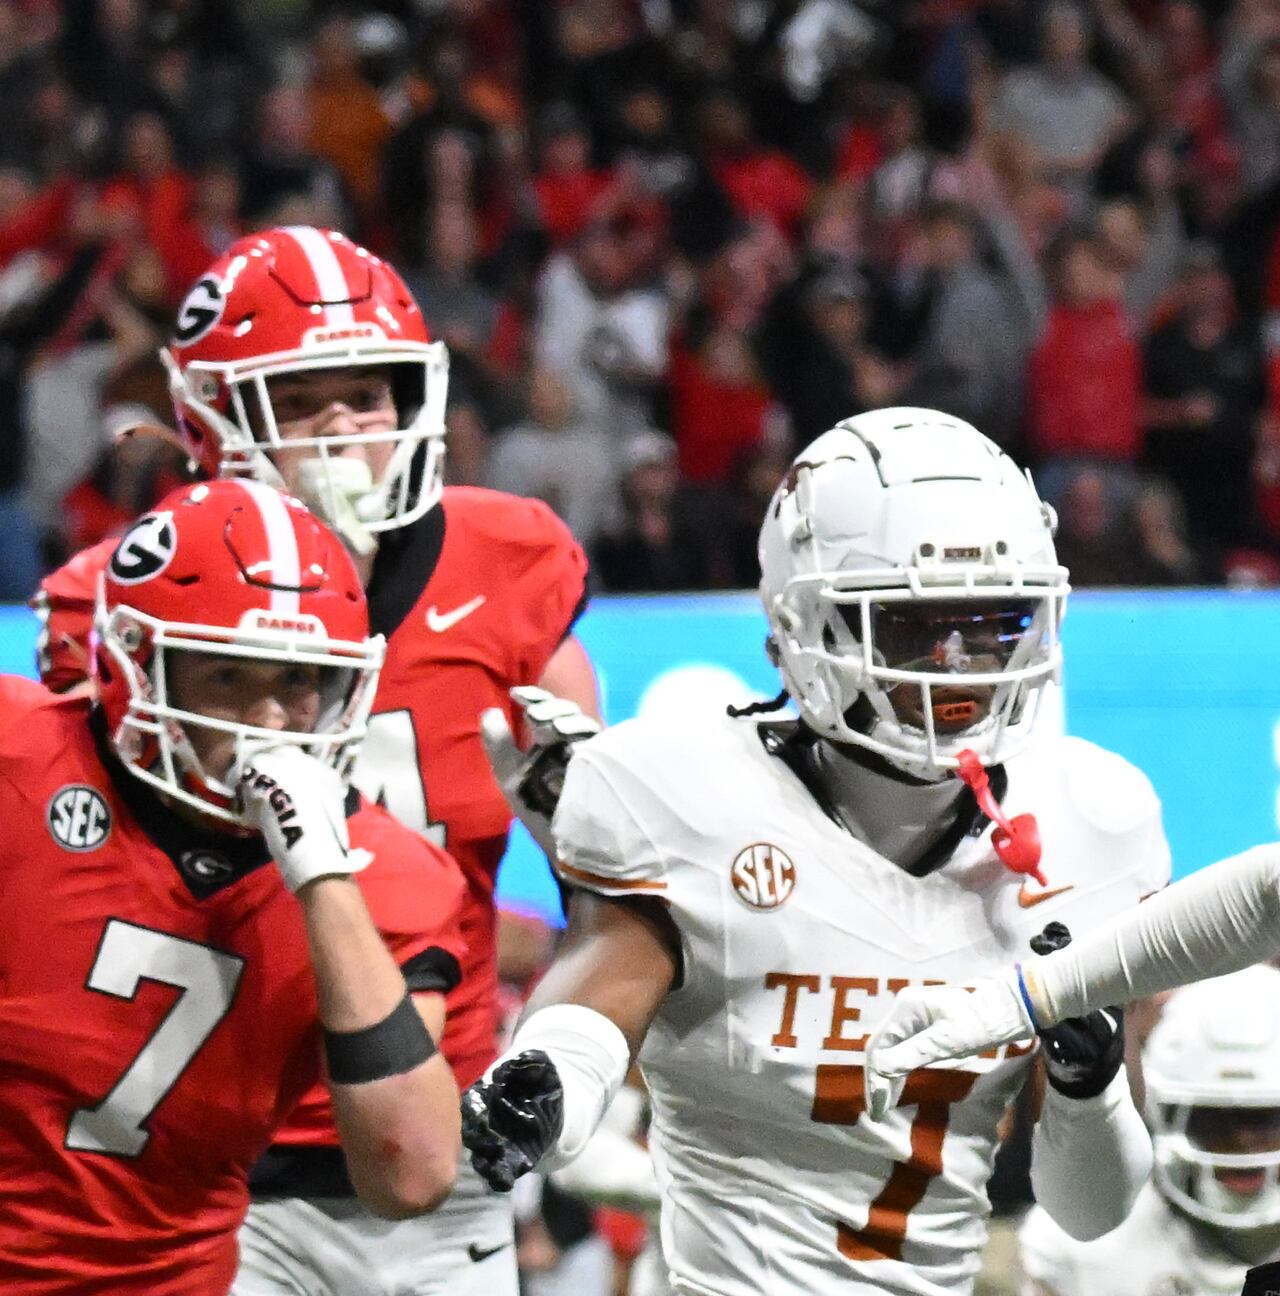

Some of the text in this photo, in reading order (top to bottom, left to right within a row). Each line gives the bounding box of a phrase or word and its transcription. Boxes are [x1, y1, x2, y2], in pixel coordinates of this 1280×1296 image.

[257, 616, 316, 633] DAWGS
[50, 787, 112, 849] SEC
[730, 843, 796, 909] SEC
[63, 917, 246, 1159] 7
